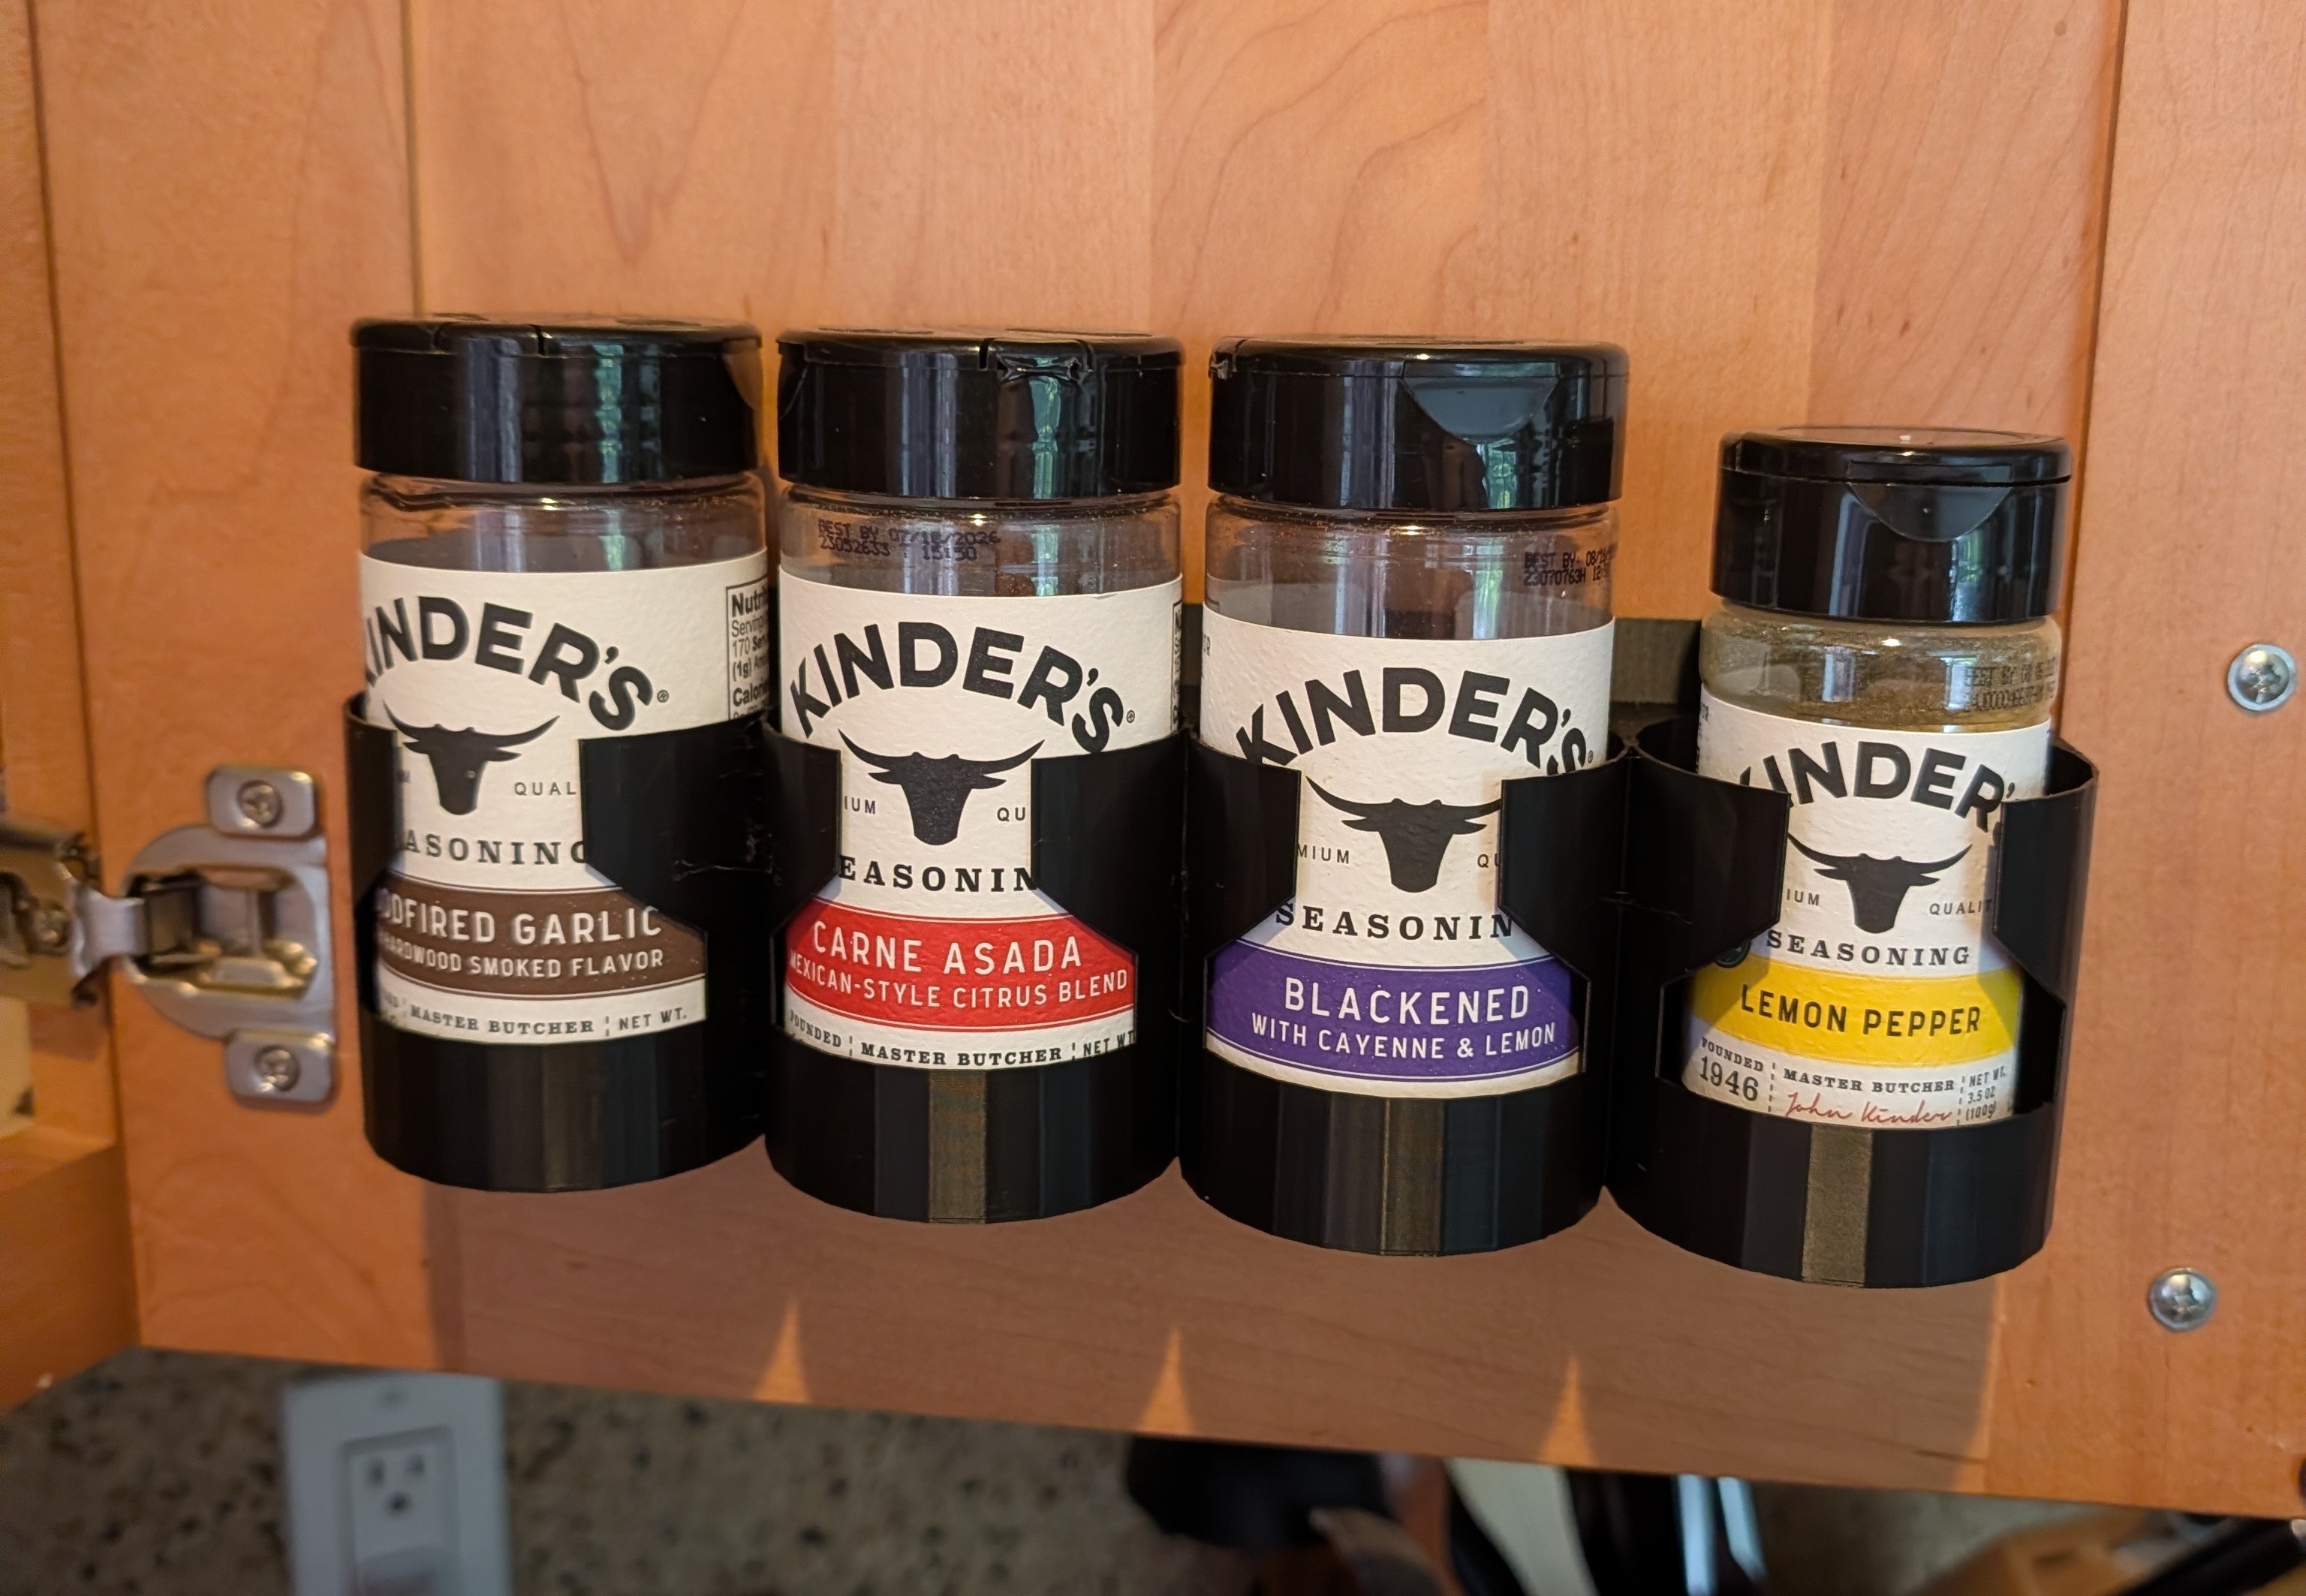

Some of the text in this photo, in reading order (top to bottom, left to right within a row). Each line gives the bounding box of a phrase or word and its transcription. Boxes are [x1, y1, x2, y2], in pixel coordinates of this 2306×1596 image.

[818, 519, 851, 538] BEST
[366, 595, 654, 731] INDER'S
[790, 621, 1124, 752] KINDER'S
[1236, 667, 1586, 775] KINDER'S
[514, 782, 576, 796] QUAL
[405, 829, 585, 865] ASONIN
[1297, 843, 1350, 864] MIUM
[840, 854, 1037, 892] EASONIN
[513, 905, 662, 946] GARLIC
[1275, 902, 1513, 941] SEASONIN
[1929, 899, 1993, 916] QUALIT
[470, 956, 561, 977] SMOKED
[572, 949, 664, 976] FLAVOR
[813, 920, 1081, 975] CARNE ASADA
[1766, 929, 1970, 966] SEASONING
[953, 983, 1047, 1008] CITRUS
[1058, 968, 1127, 1002] BLEND
[1284, 977, 1529, 1025] BLACKENED
[411, 1004, 594, 1036] MASTER BUTCHER
[619, 1013, 650, 1031] NET
[1741, 984, 1981, 1037] LEMON PEPPER
[790, 1010, 1062, 1066] FOUNDED MASTER BUTCHER
[1083, 1037, 1110, 1057] NET
[1251, 1012, 1556, 1059] WITH CAYENNE & LEMON
[1701, 1037, 1764, 1073] FOUNDED
[1699, 1057, 1759, 1102] 1946
[1783, 1068, 1955, 1093] MASTER BUTCHER
[1969, 1071, 1989, 1088] NET
[1785, 1092, 1953, 1124] John Kinder
